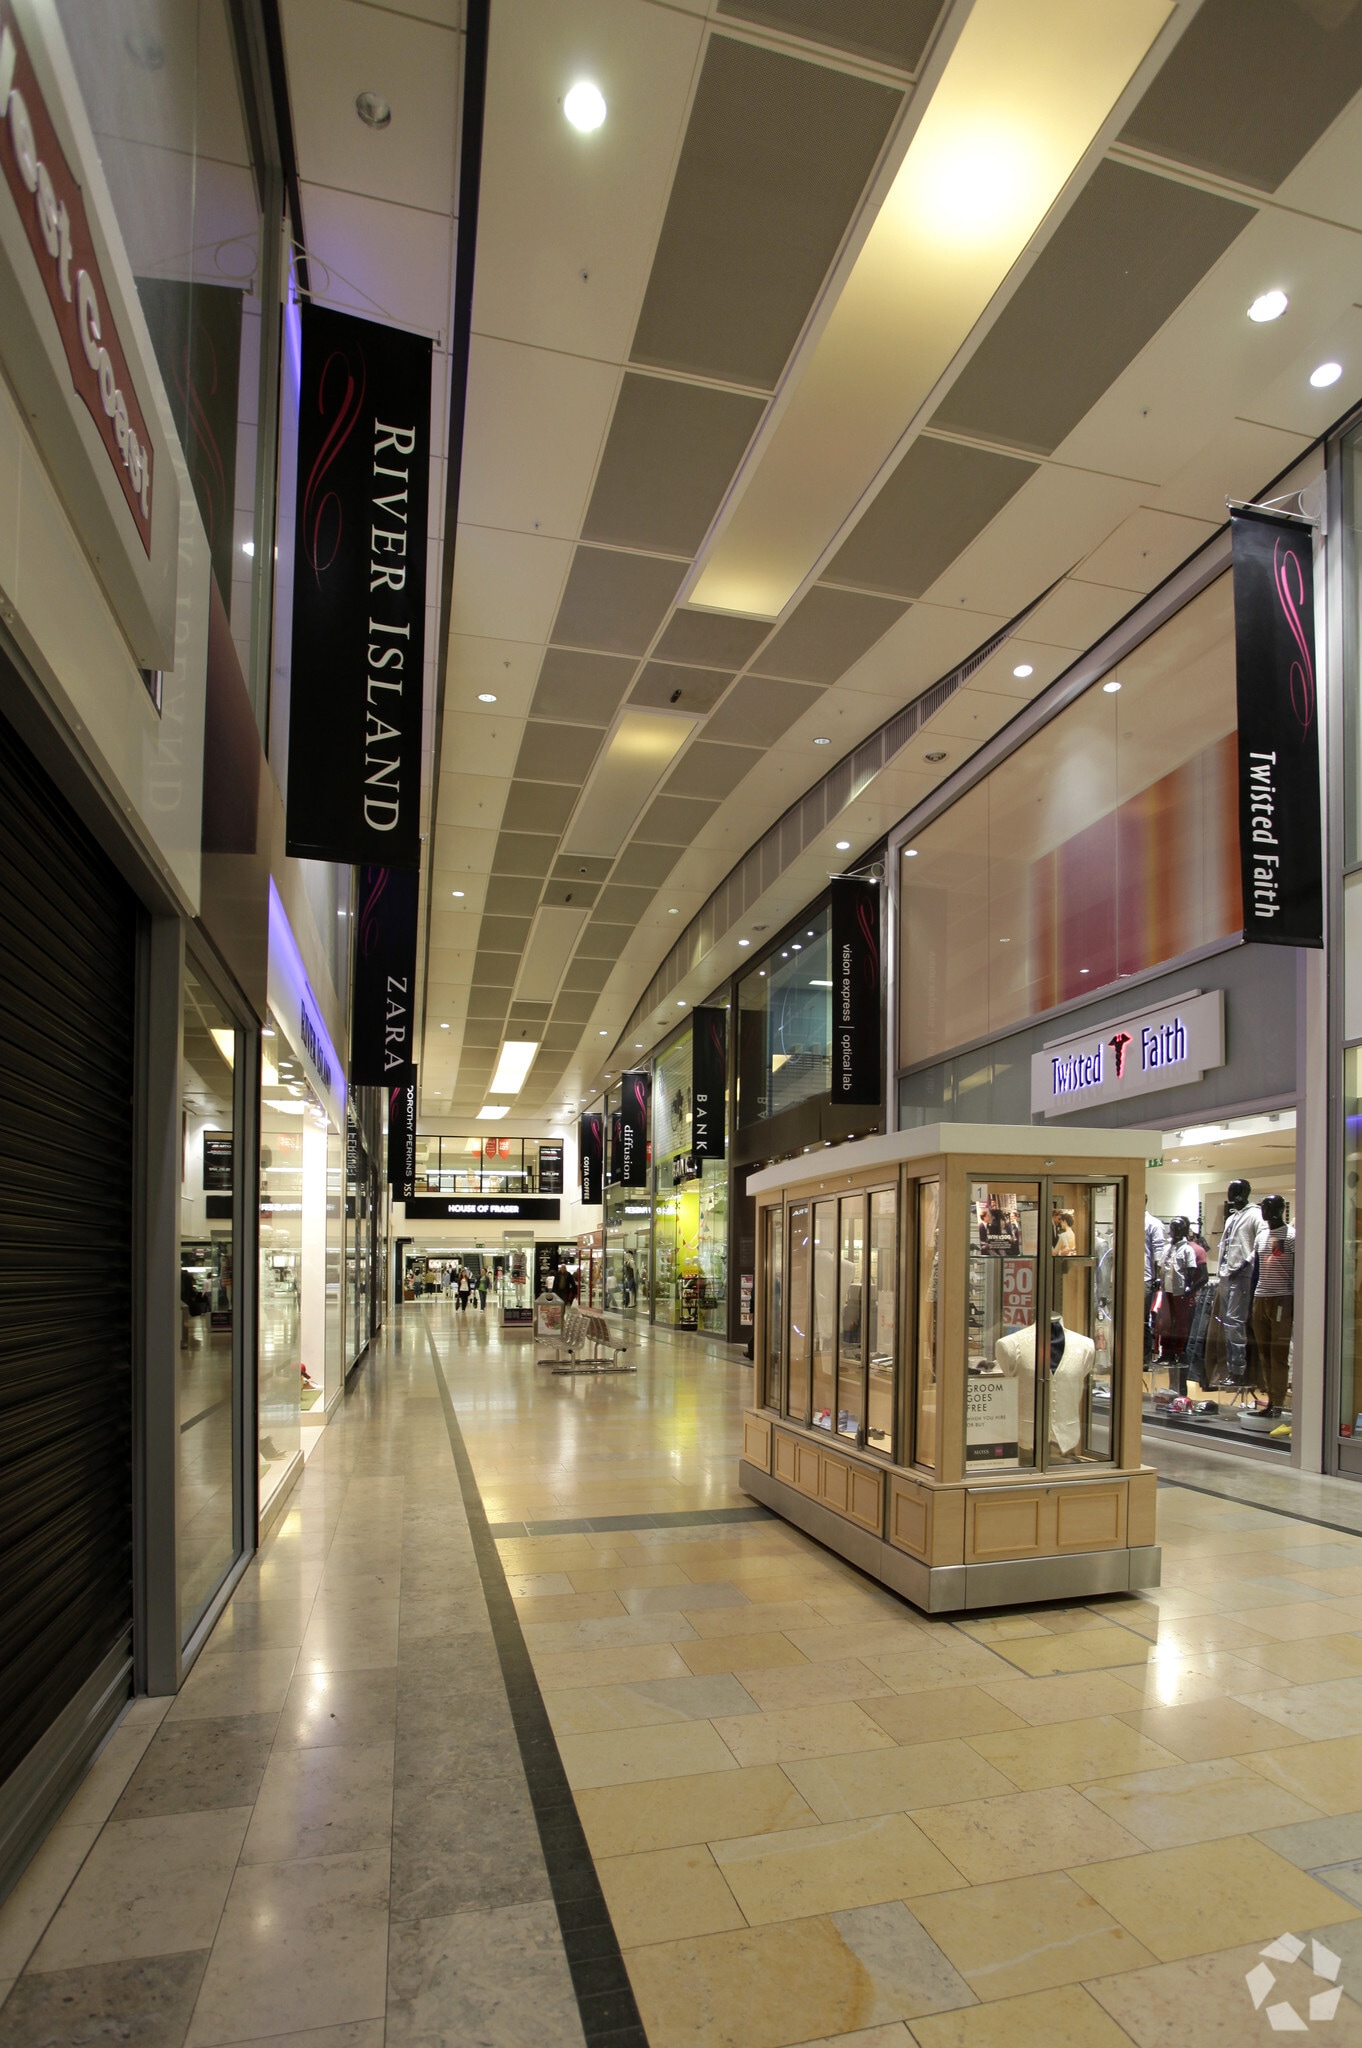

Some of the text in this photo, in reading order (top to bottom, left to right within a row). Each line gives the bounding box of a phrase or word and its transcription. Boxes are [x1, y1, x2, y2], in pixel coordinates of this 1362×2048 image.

[77, 268, 150, 520] Coast
[363, 417, 416, 832] RIVER ISLAND
[1249, 751, 1280, 918] Twisted Faith
[843, 943, 852, 975] vision
[840, 978, 850, 1022] express
[384, 976, 407, 1072] ZARA
[841, 1034, 852, 1071] optical
[1051, 1017, 1187, 1094] Twisted Faith
[843, 1073, 852, 1091] lab
[696, 1094, 708, 1150] BANK
[405, 1134, 413, 1177] PERKINS
[623, 1124, 634, 1180] diffusion
[448, 1204, 519, 1213] HOUSE OF FRASER
[976, 1187, 982, 1199] 1
[967, 1384, 1003, 1393] GROOM
[967, 1393, 992, 1403] GOES
